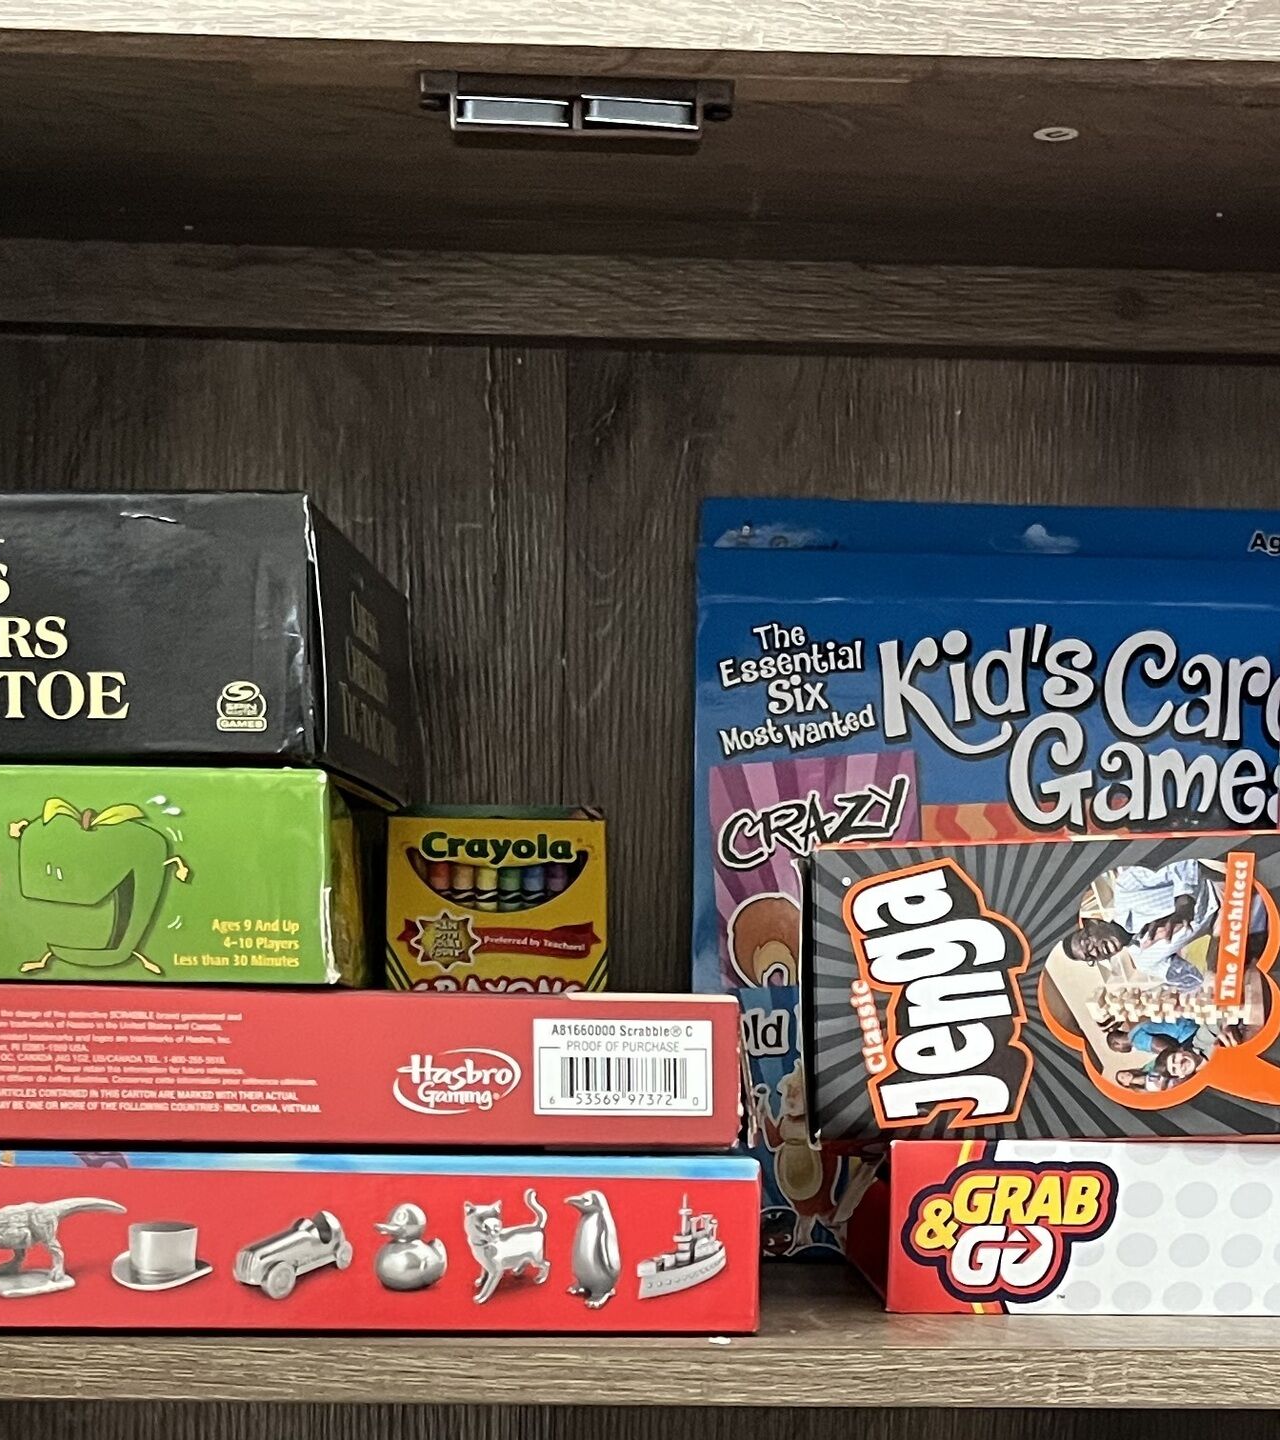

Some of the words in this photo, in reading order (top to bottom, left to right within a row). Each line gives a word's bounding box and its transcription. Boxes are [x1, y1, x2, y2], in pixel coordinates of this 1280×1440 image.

[753, 623, 806, 651] The
[719, 640, 863, 688] Essential
[767, 675, 828, 715] Six
[878, 624, 1097, 756] Kid's
[719, 718, 784, 756] Most
[718, 774, 910, 870] CRAZY
[421, 831, 575, 865] Crayola
[212, 919, 241, 934] Ages
[244, 919, 252, 932] 9
[255, 919, 280, 932] And
[282, 919, 300, 935] Up
[1224, 859, 1249, 960] Architect
[174, 953, 199, 966] Less
[201, 954, 230, 966] than
[234, 954, 248, 966] 30
[251, 954, 300, 967] Minutes
[256, 937, 300, 952] Players
[852, 868, 1013, 1120] Jenga
[1219, 963, 1236, 1000] The
[566, 1041, 602, 1052] PROOF
[605, 1041, 620, 1052] OF
[622, 1041, 680, 1053] PURCHASE
[396, 1053, 516, 1087] Hasbro
[417, 1082, 495, 1110] Gaming
[954, 1174, 1102, 1228] GRAB
[916, 1199, 958, 1250] &
[951, 1227, 1056, 1287] GO
